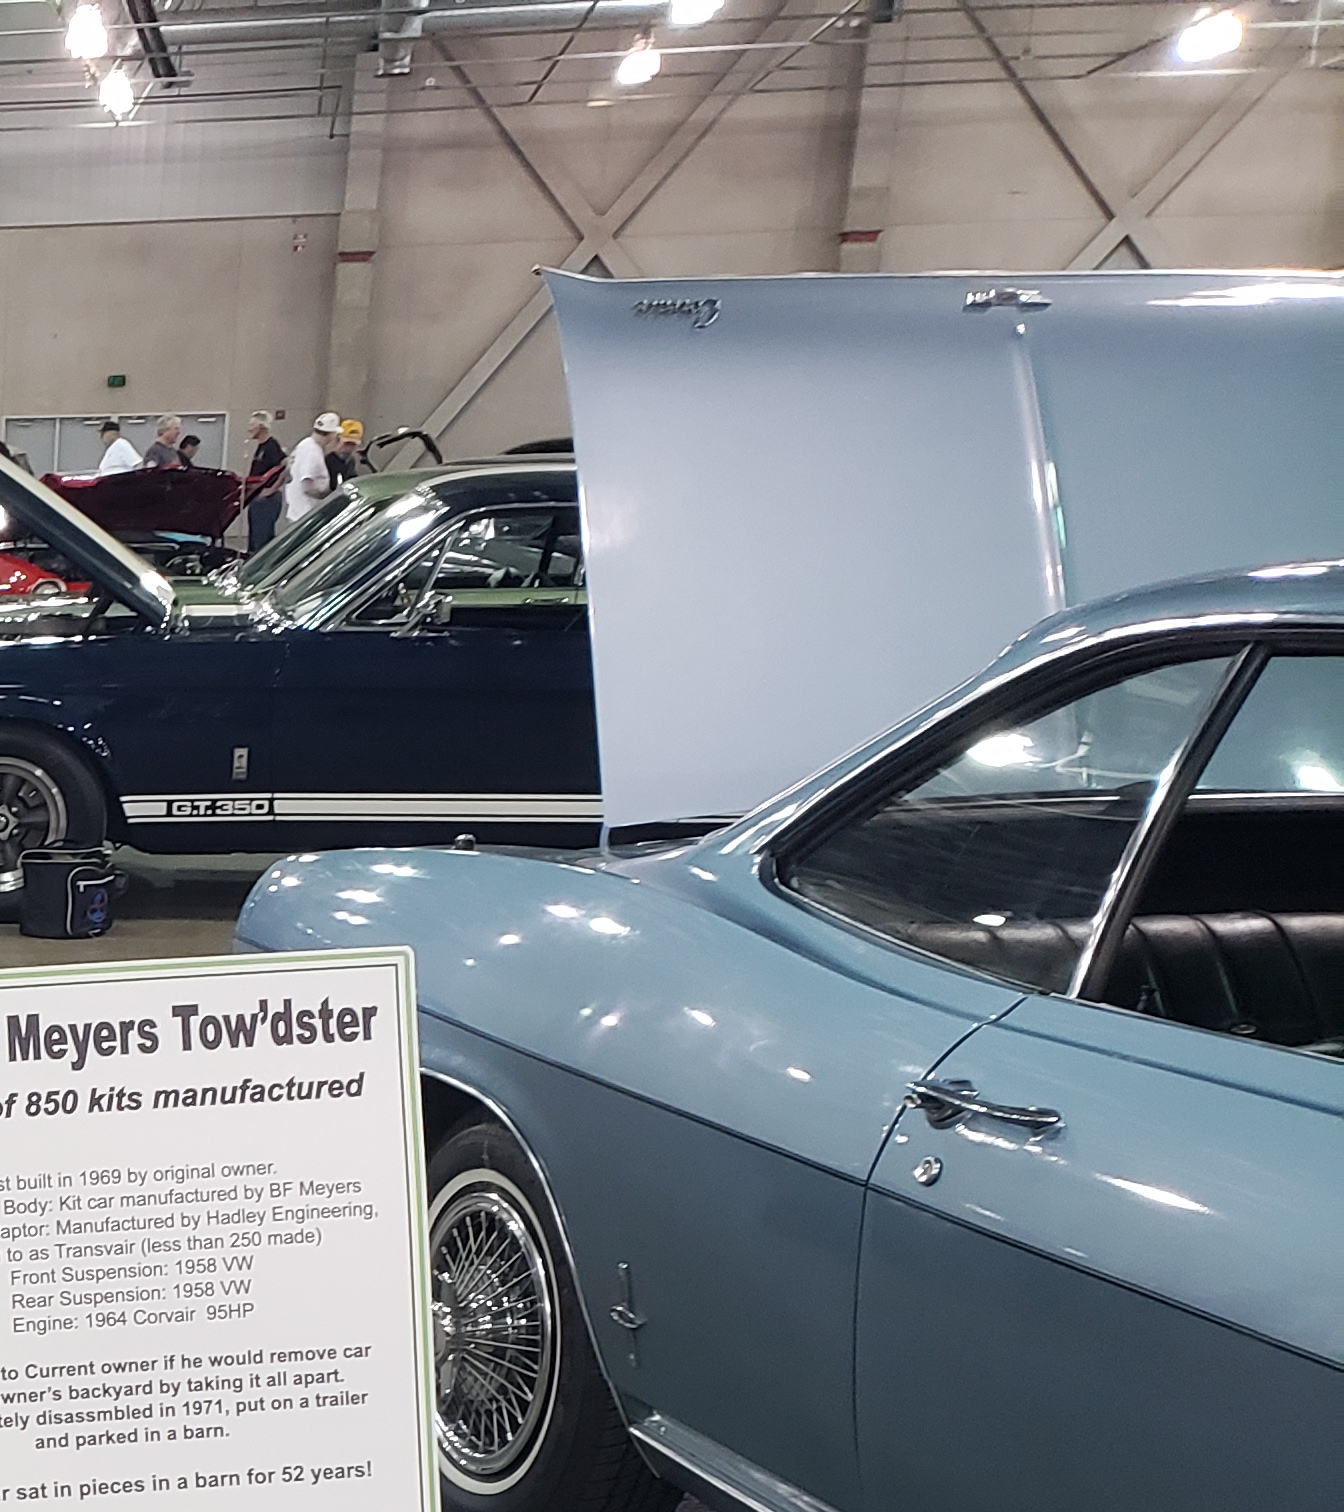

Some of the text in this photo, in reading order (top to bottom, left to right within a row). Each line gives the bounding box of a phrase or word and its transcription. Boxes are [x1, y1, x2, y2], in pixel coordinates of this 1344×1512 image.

[5, 1012, 161, 1073] Meyers
[24, 1088, 80, 1119] 850
[86, 1084, 144, 1115] kits
[151, 1070, 367, 1111] manufactured
[15, 1172, 54, 1192] built
[56, 1171, 74, 1189] in
[78, 1167, 123, 1187] 1969
[126, 1166, 149, 1188] by
[152, 1161, 217, 1185] original
[219, 1161, 279, 1179] owner.
[2, 1196, 54, 1218] Body:
[58, 1194, 84, 1213] Kit
[86, 1195, 116, 1211] car
[119, 1183, 239, 1209] manufactured
[242, 1183, 266, 1205] by
[268, 1180, 295, 1200] BF
[298, 1178, 363, 1200] Meyers
[55, 1211, 176, 1237] Manufactured
[179, 1210, 202, 1232] by
[205, 1206, 267, 1228] Hadley
[271, 1200, 380, 1226] Engineering,
[5, 1246, 25, 1264] to
[28, 1247, 51, 1262] as
[52, 1238, 137, 1260] Transvair
[140, 1236, 183, 1259] (less
[185, 1233, 226, 1252] than
[228, 1230, 263, 1250] 250
[266, 1226, 323, 1248] made)
[9, 1253, 255, 1287] Front Suspension: 1958 VW
[10, 1277, 253, 1311] Rear Suspension: 1958 VW
[12, 1301, 256, 1337] Engine: 1964 Corvair 95HP
[0, 1365, 20, 1382] to
[24, 1359, 97, 1381] Current
[99, 1358, 160, 1376] owner
[162, 1353, 177, 1372] if
[179, 1352, 204, 1370] he
[206, 1348, 265, 1368] would
[269, 1347, 338, 1365] remove
[342, 1344, 373, 1360] car
[67, 1378, 154, 1403] backyard
[158, 1378, 183, 1399] by
[185, 1374, 244, 1395] taking
[248, 1372, 263, 1390] it
[265, 1369, 288, 1389] all
[292, 1367, 346, 1390] apart.
[34, 1402, 154, 1427] disassmbled
[157, 1401, 177, 1419] in
[181, 1397, 231, 1417] 1971,
[234, 1396, 267, 1418] put
[270, 1397, 295, 1412] on
[298, 1396, 311, 1410] a
[314, 1389, 370, 1409] trailer
[34, 1423, 231, 1452] and parked in a barn.
[15, 1481, 49, 1502] sat
[52, 1480, 73, 1499] in
[78, 1477, 146, 1502] pieces
[150, 1473, 171, 1493] in
[176, 1475, 189, 1491] a
[193, 1470, 242, 1490] barn
[245, 1466, 278, 1486] for
[280, 1464, 306, 1484] 52
[309, 1459, 373, 1486] years!
